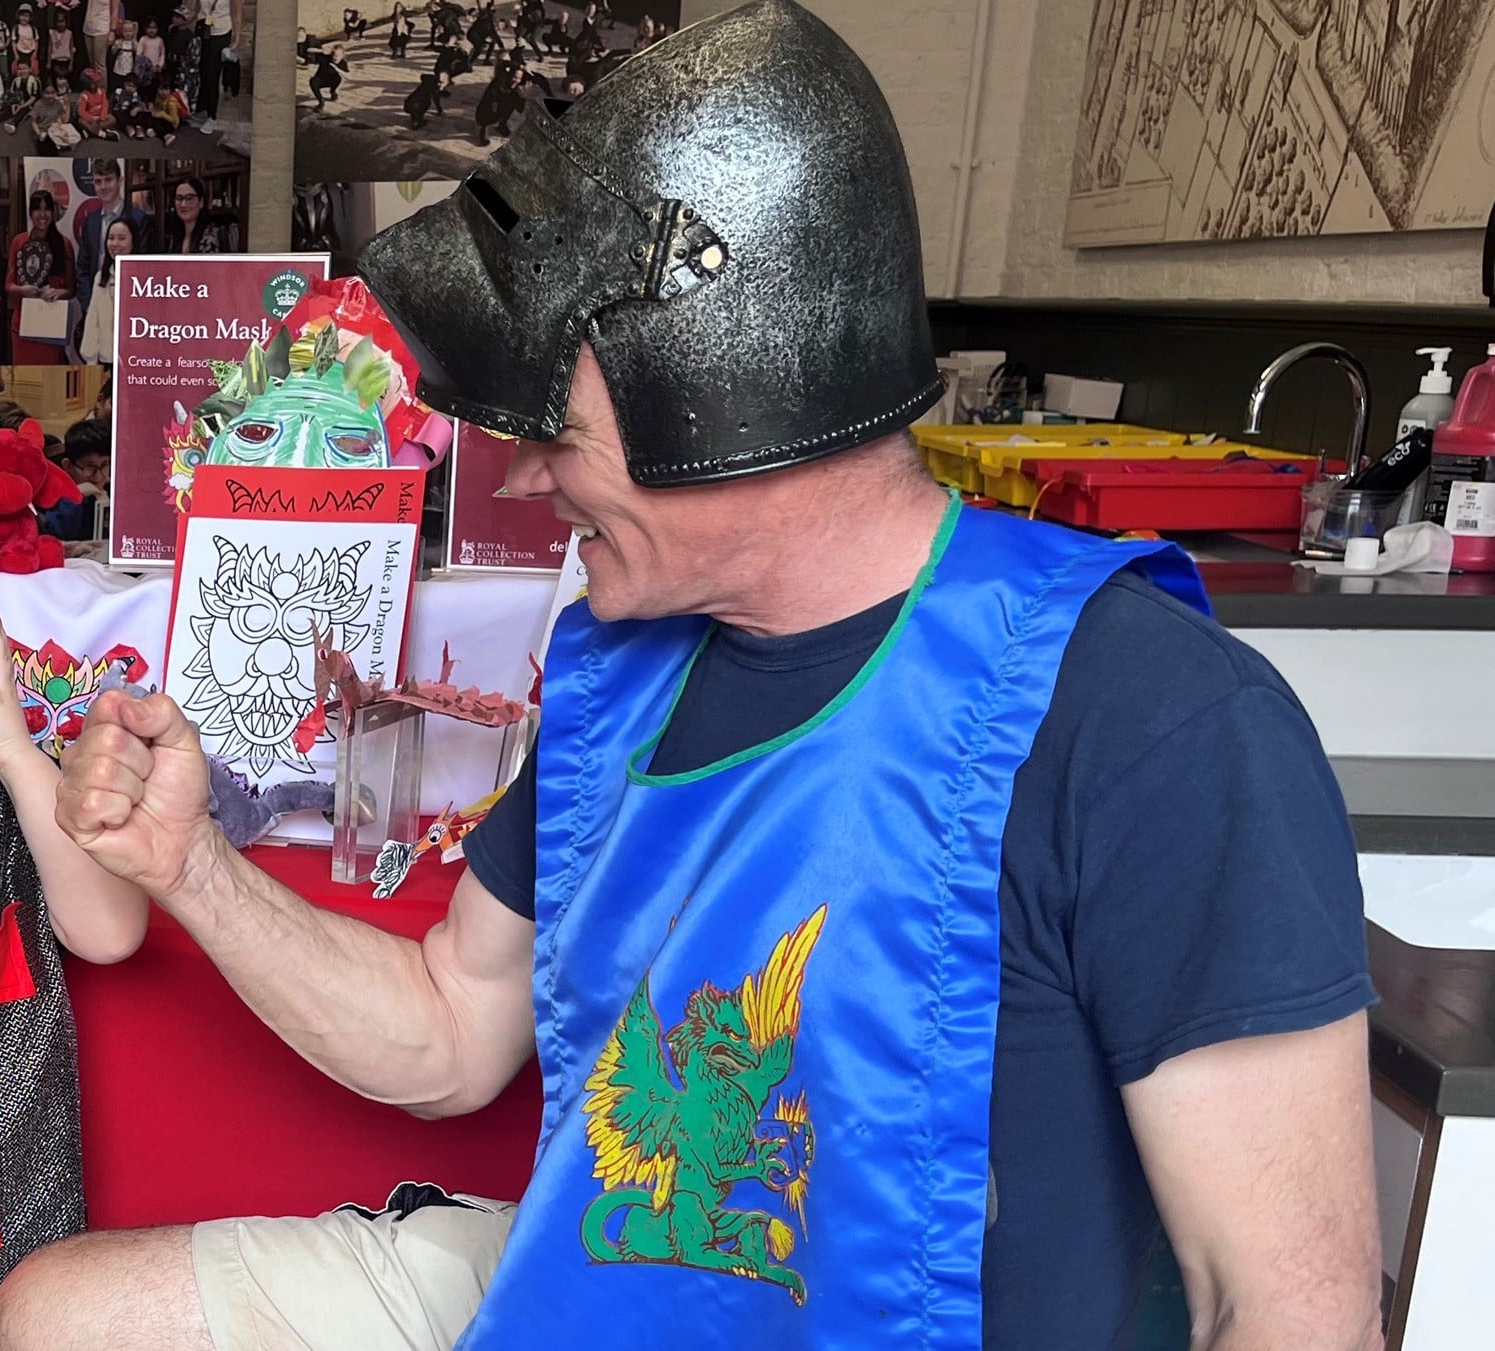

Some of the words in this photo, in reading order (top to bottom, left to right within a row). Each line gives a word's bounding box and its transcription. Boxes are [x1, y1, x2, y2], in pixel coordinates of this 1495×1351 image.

[130, 275, 190, 298] Make
[197, 283, 209, 298] a
[270, 274, 305, 288] WINDSOR
[129, 317, 209, 344] Dragon
[215, 317, 272, 341] Mask
[127, 355, 162, 368] Create
[165, 358, 171, 368] a
[127, 373, 147, 385] that
[150, 374, 177, 386] could
[180, 377, 204, 386] even
[135, 537, 163, 545] ROYAL
[477, 542, 507, 551] ROYAL
[135, 545, 176, 553] COLLECTI
[136, 551, 162, 559] TRUST
[382, 539, 401, 581] Make
[476, 550, 535, 560] COLLECTION
[477, 558, 506, 566] TRUST
[380, 586, 391, 594] a
[371, 599, 393, 657] Dragon
